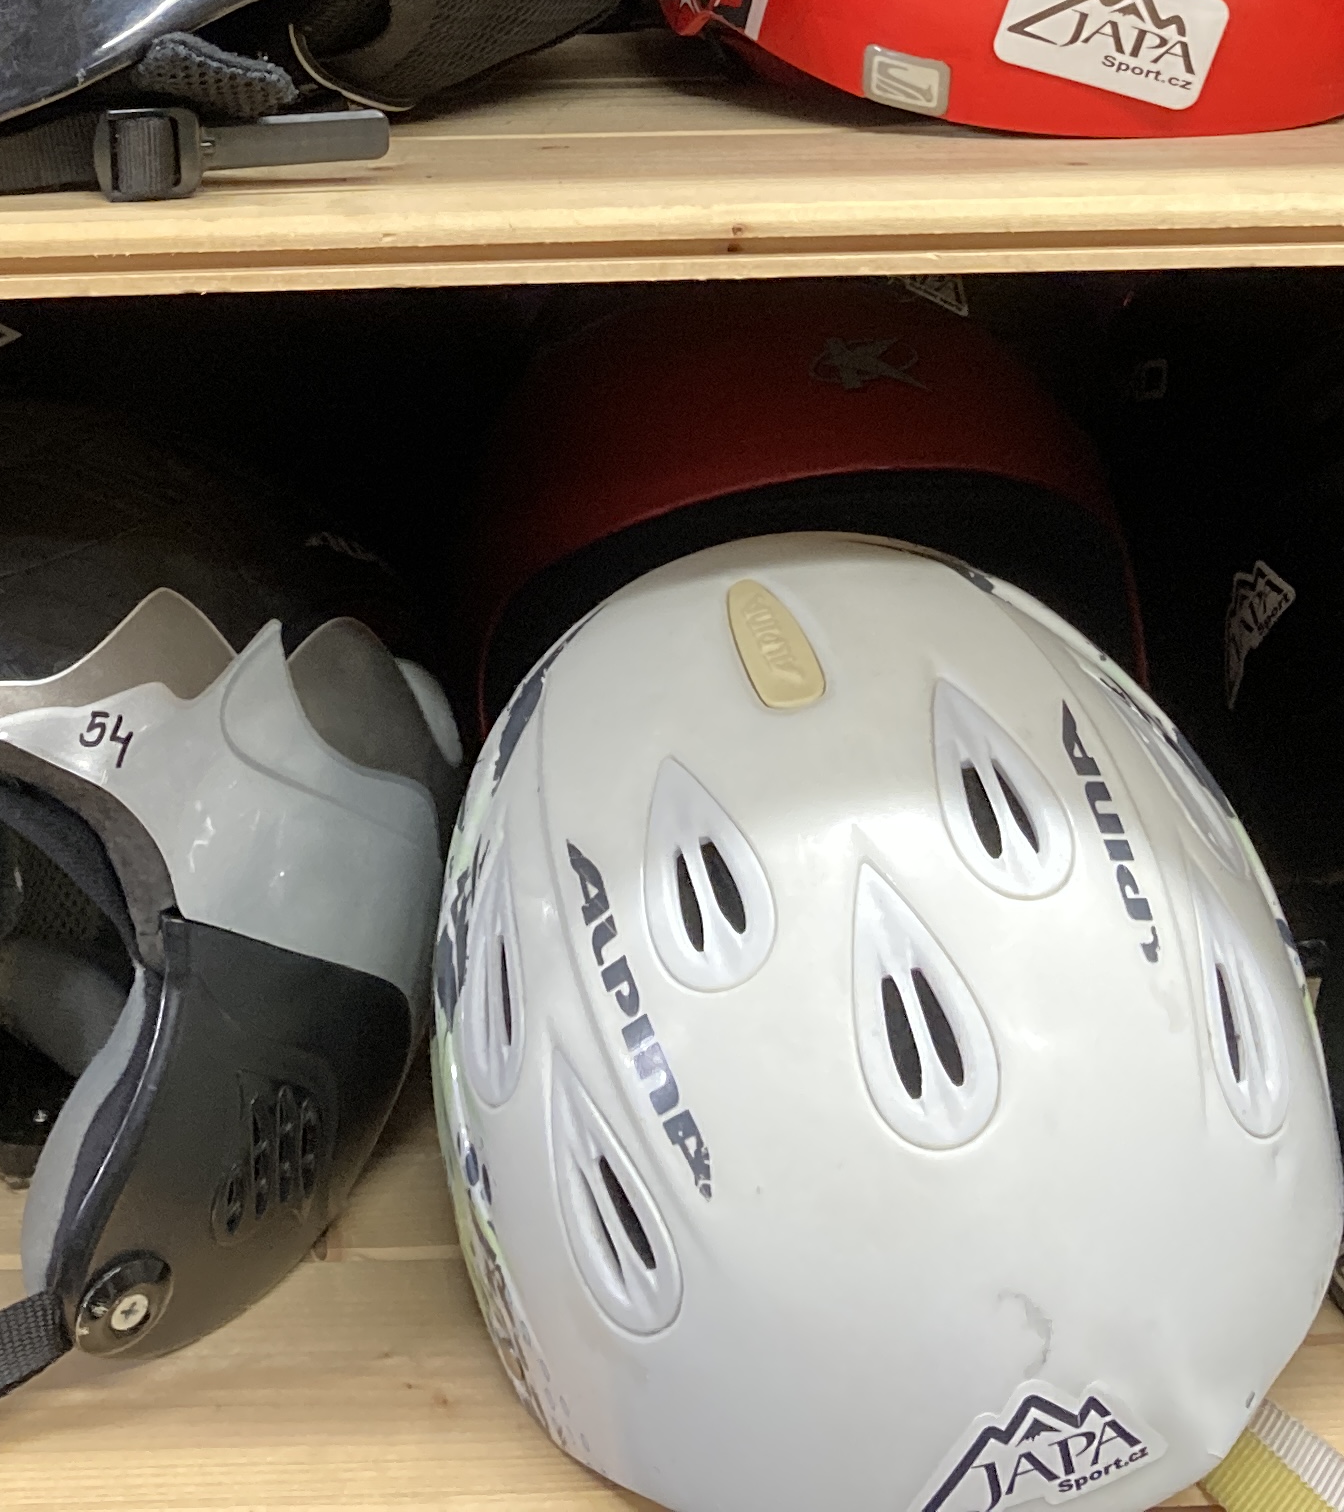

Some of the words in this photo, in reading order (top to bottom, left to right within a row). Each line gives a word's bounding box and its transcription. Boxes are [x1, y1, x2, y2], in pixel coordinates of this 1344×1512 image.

[1059, 8, 1196, 76] JAPA
[1101, 54, 1194, 91] Sport.cz
[79, 710, 134, 769] 54
[566, 838, 712, 1203] ALPINA
[970, 1418, 1143, 1512] JAPA
[1058, 1445, 1149, 1493] Sport.cz
